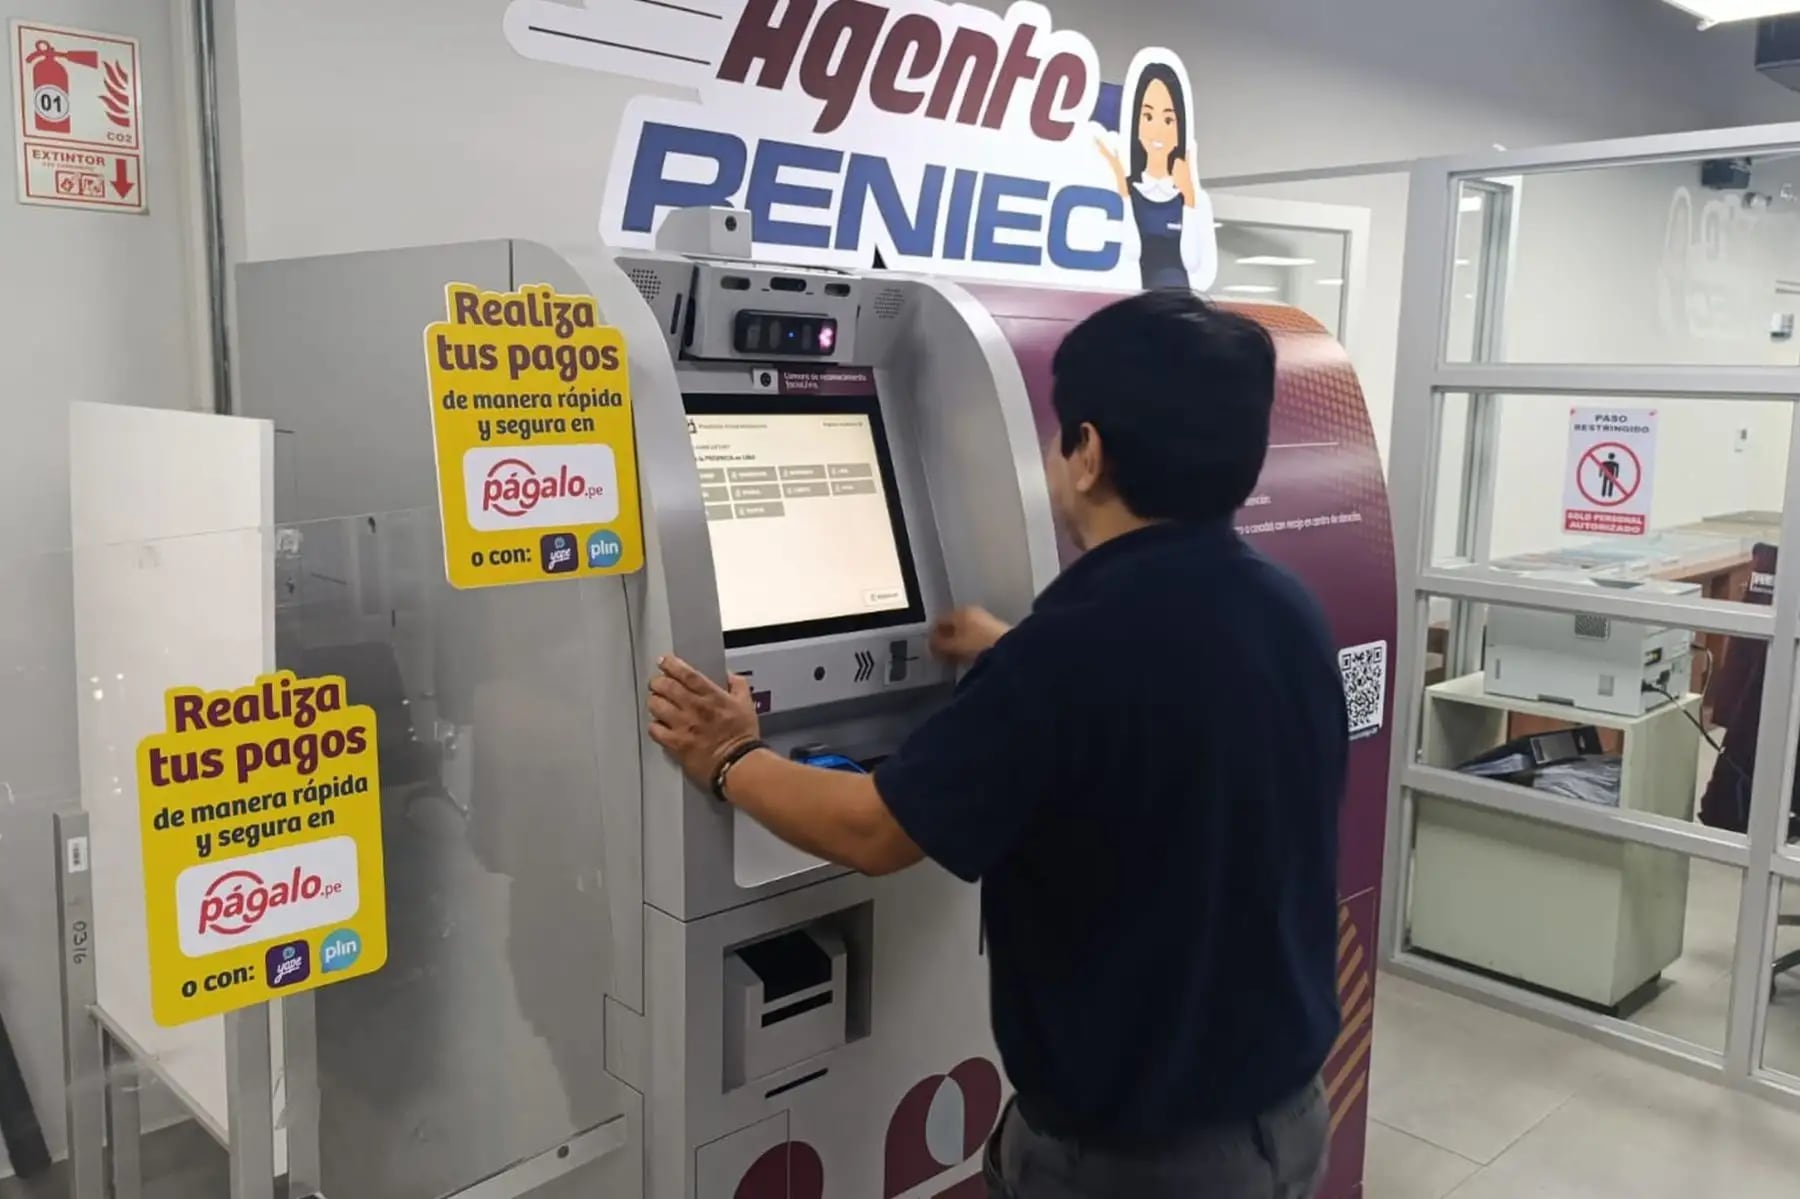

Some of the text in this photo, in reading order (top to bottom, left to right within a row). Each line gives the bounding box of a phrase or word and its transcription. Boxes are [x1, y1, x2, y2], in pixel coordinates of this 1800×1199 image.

[716, 0, 1087, 142] Agente
[40, 93, 62, 113] 01
[106, 131, 133, 143] CO2
[32, 149, 106, 167] EXTINTOR
[621, 121, 1125, 272] RENIEC
[454, 291, 595, 339] Realiza
[436, 333, 619, 383] tus pagos
[442, 386, 623, 412] de manera rápida
[478, 416, 595, 441] y segura en
[1573, 423, 1650, 434] RESTRINGIDO
[1594, 414, 1628, 423] PASO
[1567, 511, 1643, 525] SOLO PERSONAL
[1569, 521, 1641, 533] AUTORIZADO
[471, 548, 531, 567] o con:
[548, 546, 572, 571] yape
[590, 539, 619, 560] plin
[174, 678, 341, 733] Realiza
[149, 726, 367, 787] tus pagos
[153, 774, 368, 830] de manera rápida
[196, 809, 335, 858] y segura en
[72, 920, 88, 965] 0316
[325, 939, 357, 963] plin
[181, 965, 255, 998] o con:
[274, 956, 303, 984] yape
